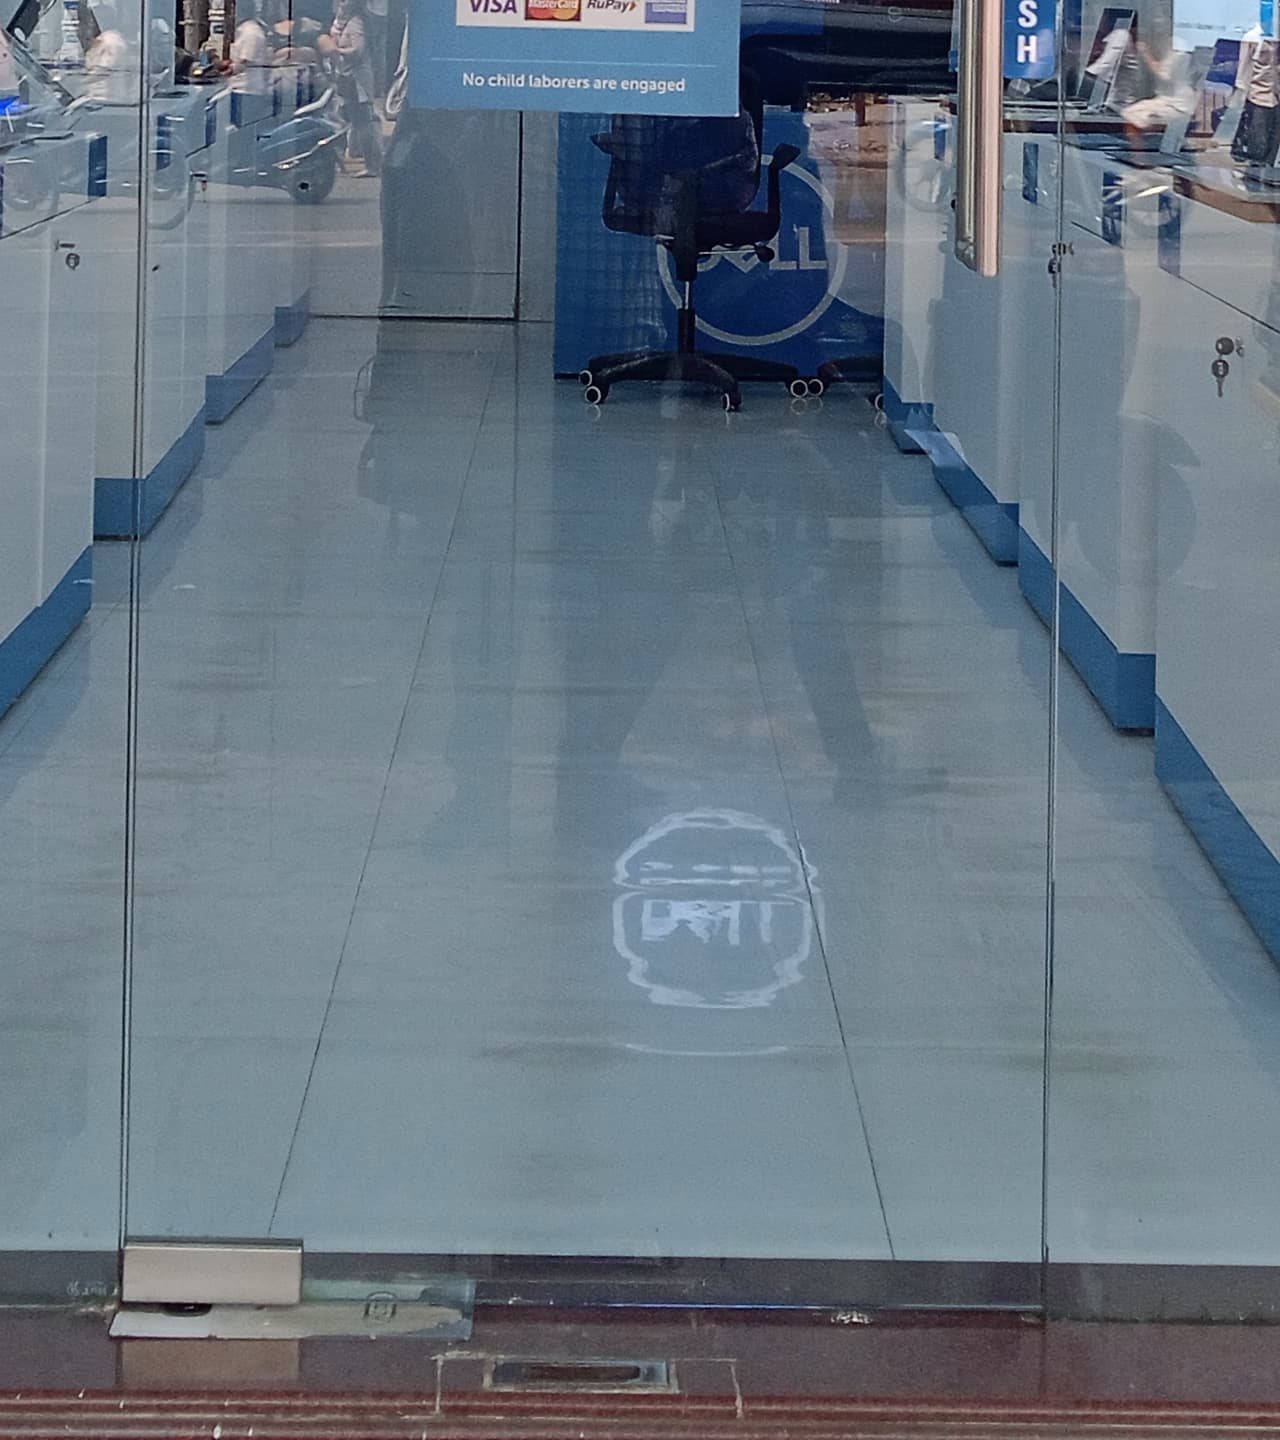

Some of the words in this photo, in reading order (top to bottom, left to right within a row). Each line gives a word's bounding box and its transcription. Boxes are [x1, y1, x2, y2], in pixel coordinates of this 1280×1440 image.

[463, 73, 483, 87] No
[487, 73, 525, 89] child
[529, 74, 589, 90] laborers
[594, 78, 618, 91] are
[621, 77, 686, 93] engaged
